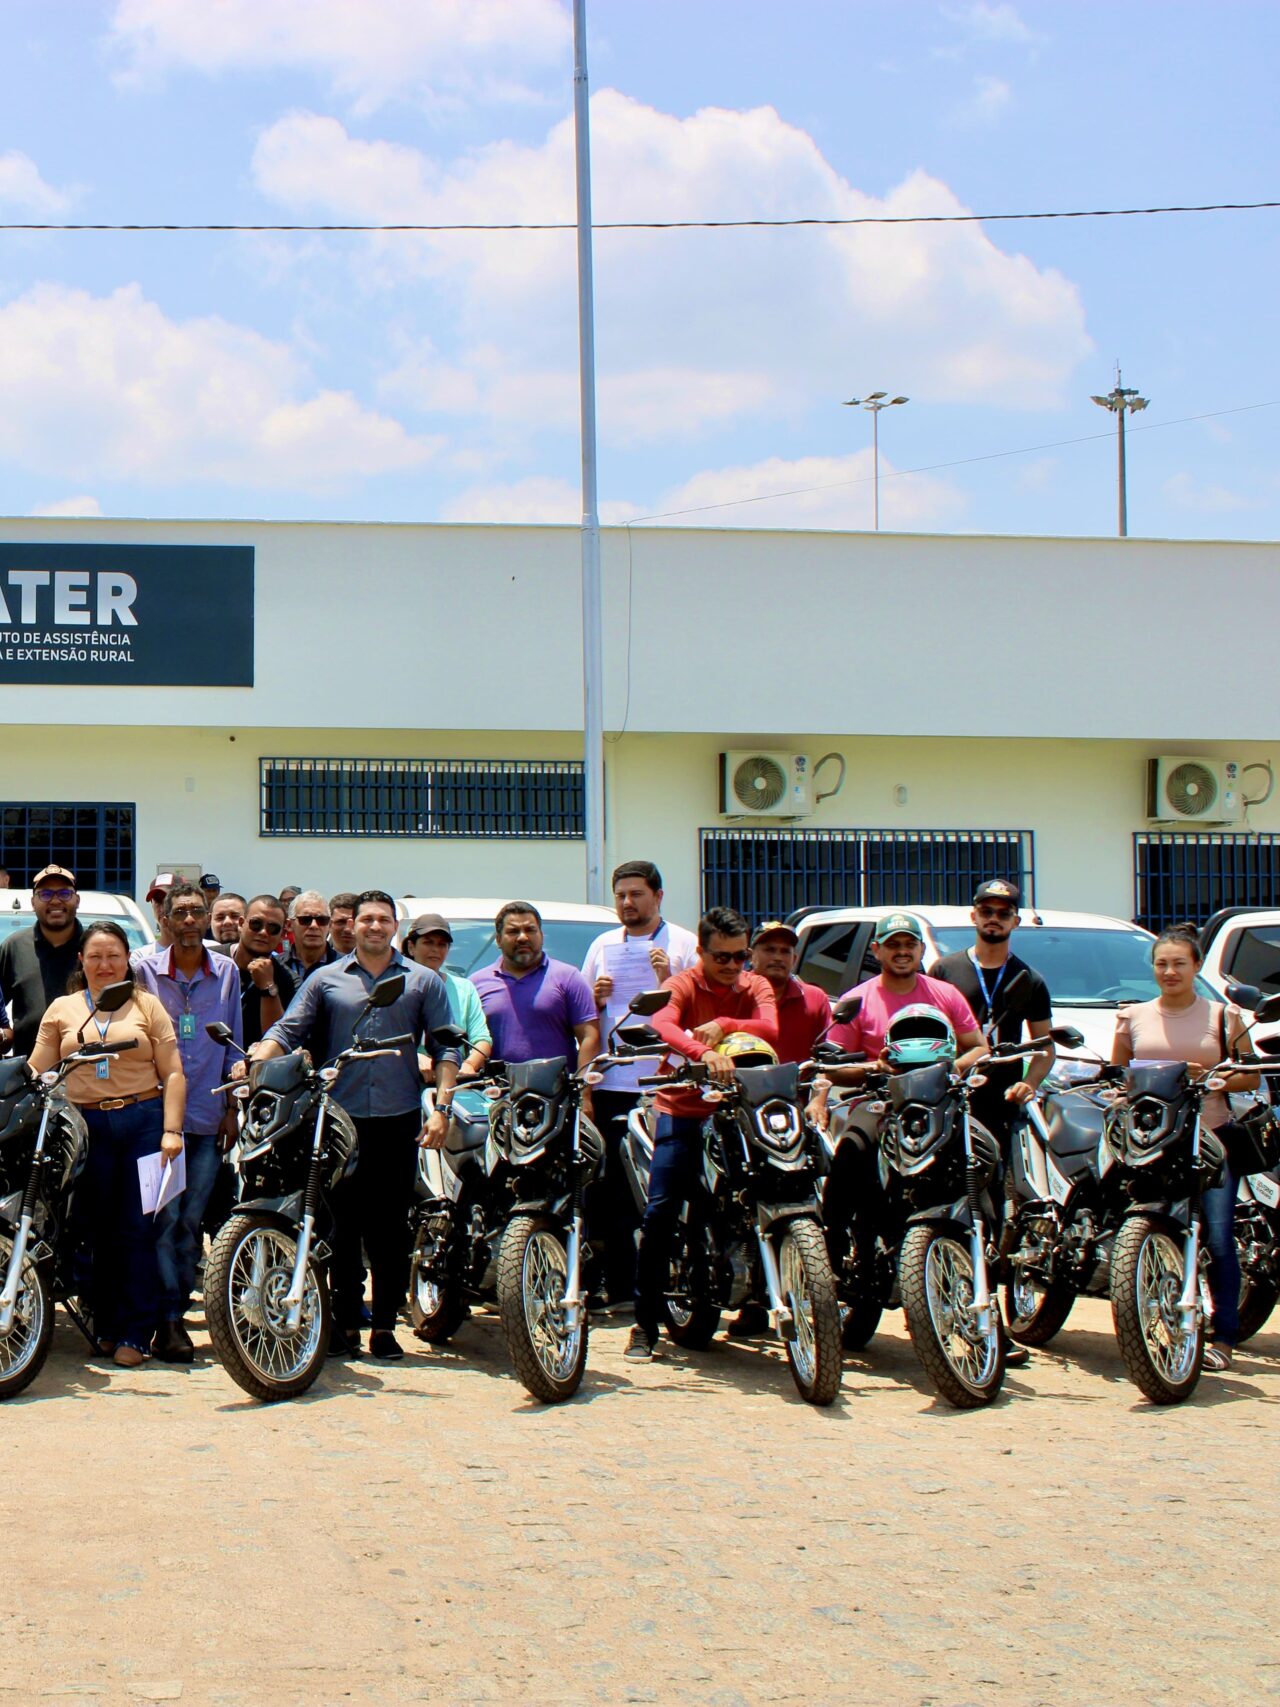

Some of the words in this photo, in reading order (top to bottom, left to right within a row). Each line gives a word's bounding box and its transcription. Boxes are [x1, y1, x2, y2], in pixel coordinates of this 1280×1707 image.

[23, 632, 41, 644] DE
[43, 630, 131, 645] ASSISTÊNCIA
[6, 648, 14, 660] E
[17, 647, 87, 662] EXTENSÃO
[90, 650, 135, 662] RURAL
